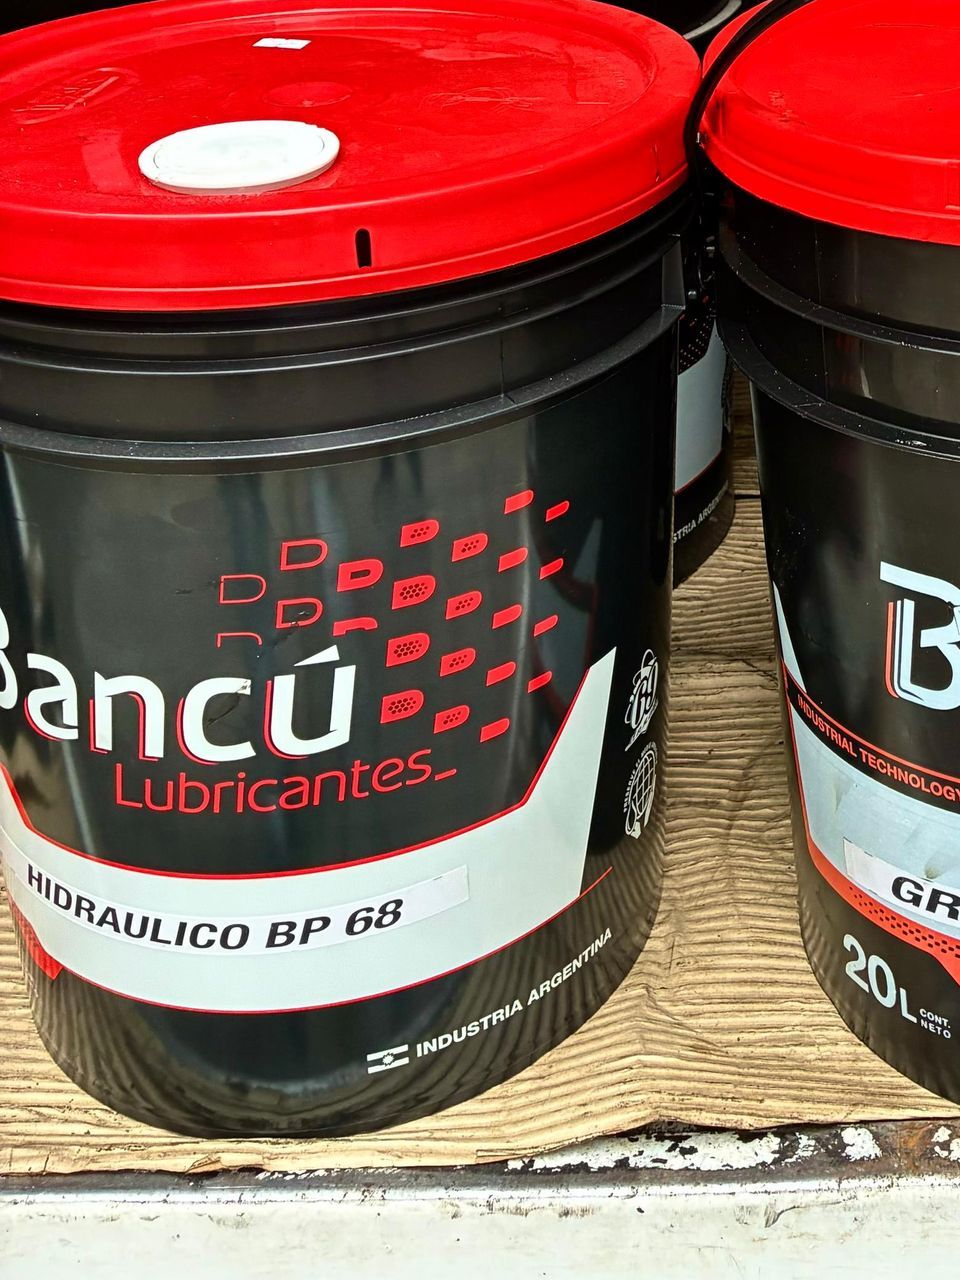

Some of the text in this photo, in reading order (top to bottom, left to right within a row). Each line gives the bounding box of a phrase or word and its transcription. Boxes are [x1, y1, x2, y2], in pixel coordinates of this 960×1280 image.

[797, 693, 858, 758] INDUSTRIAL
[26, 864, 404, 951] HIDRAULICO BP 68
[415, 927, 613, 1058] INDUSTRIA ARGENTINA
[919, 1008, 951, 1029] CONT.
[920, 1018, 952, 1039] NETO
